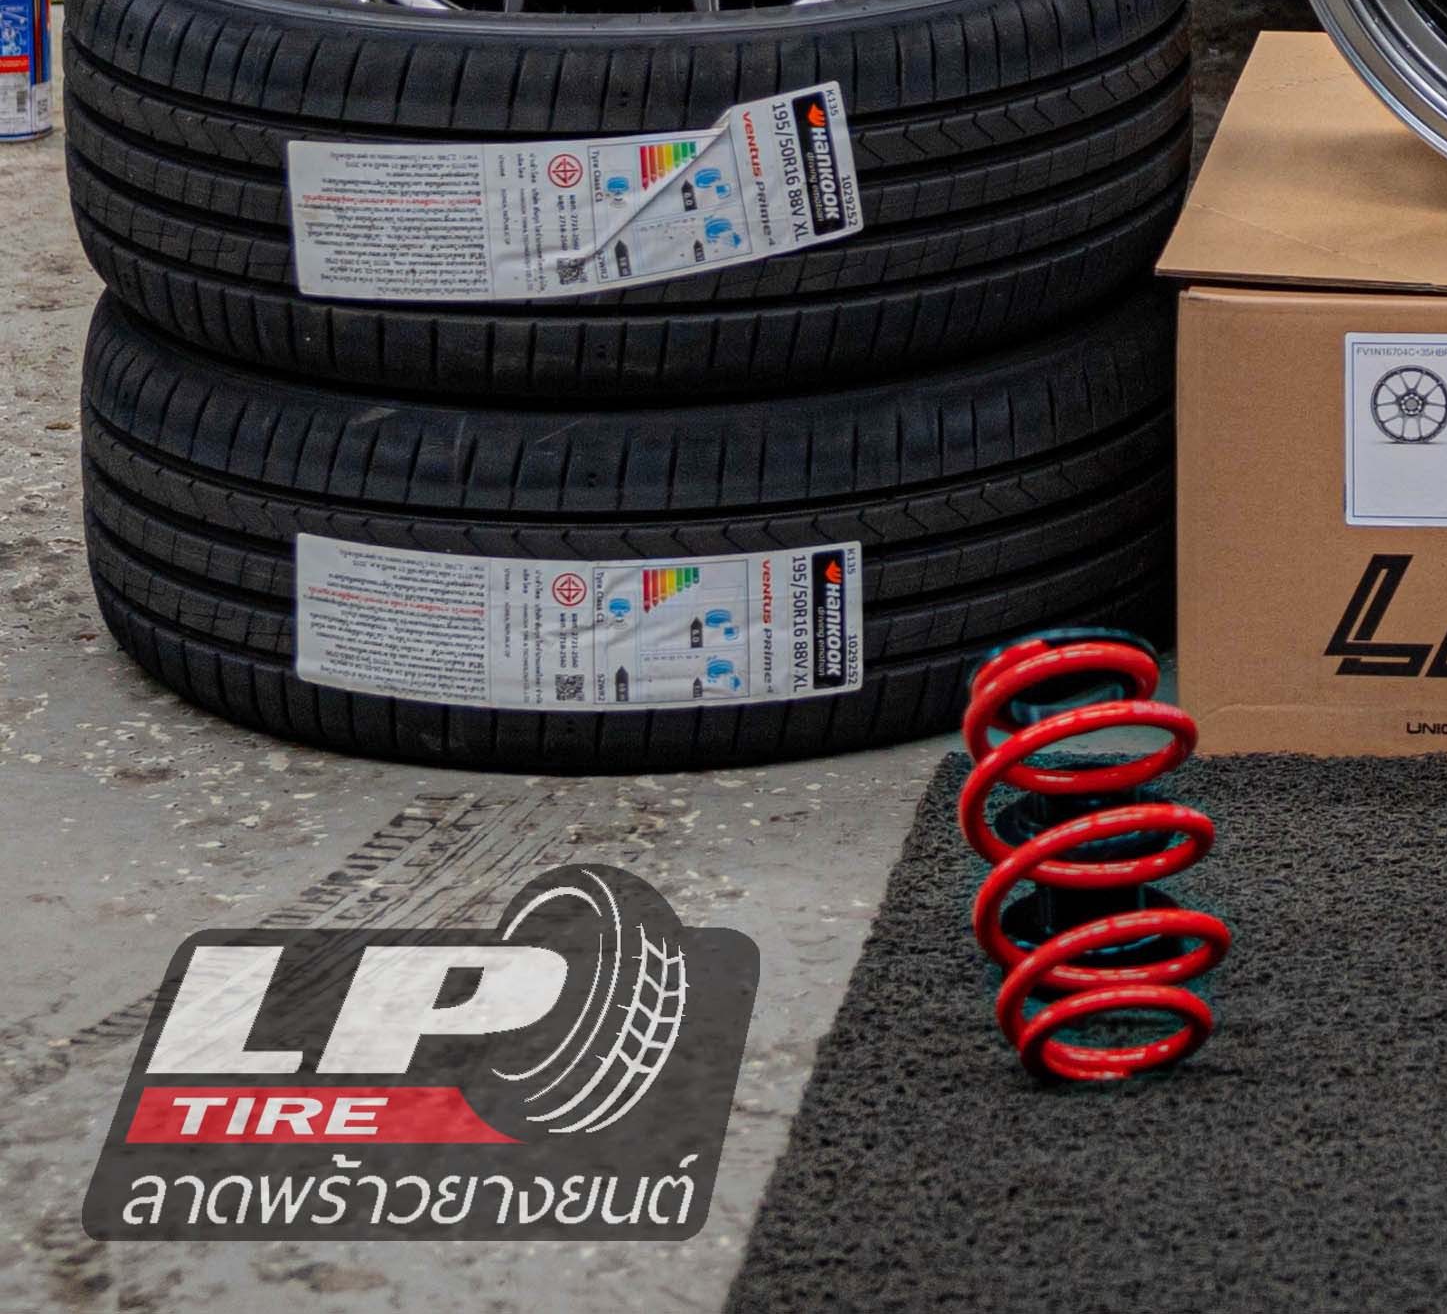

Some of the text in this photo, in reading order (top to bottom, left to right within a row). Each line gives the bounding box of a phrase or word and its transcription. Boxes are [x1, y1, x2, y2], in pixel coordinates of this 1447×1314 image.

[826, 89, 839, 117] K135
[771, 102, 809, 242] 195/50R16 88V XL
[806, 152, 825, 221] driving emotion
[841, 175, 858, 227] 1029252
[790, 556, 808, 692] 195/50R16 88V XL
[817, 607, 825, 637] driving
[848, 635, 857, 685] 1029252
